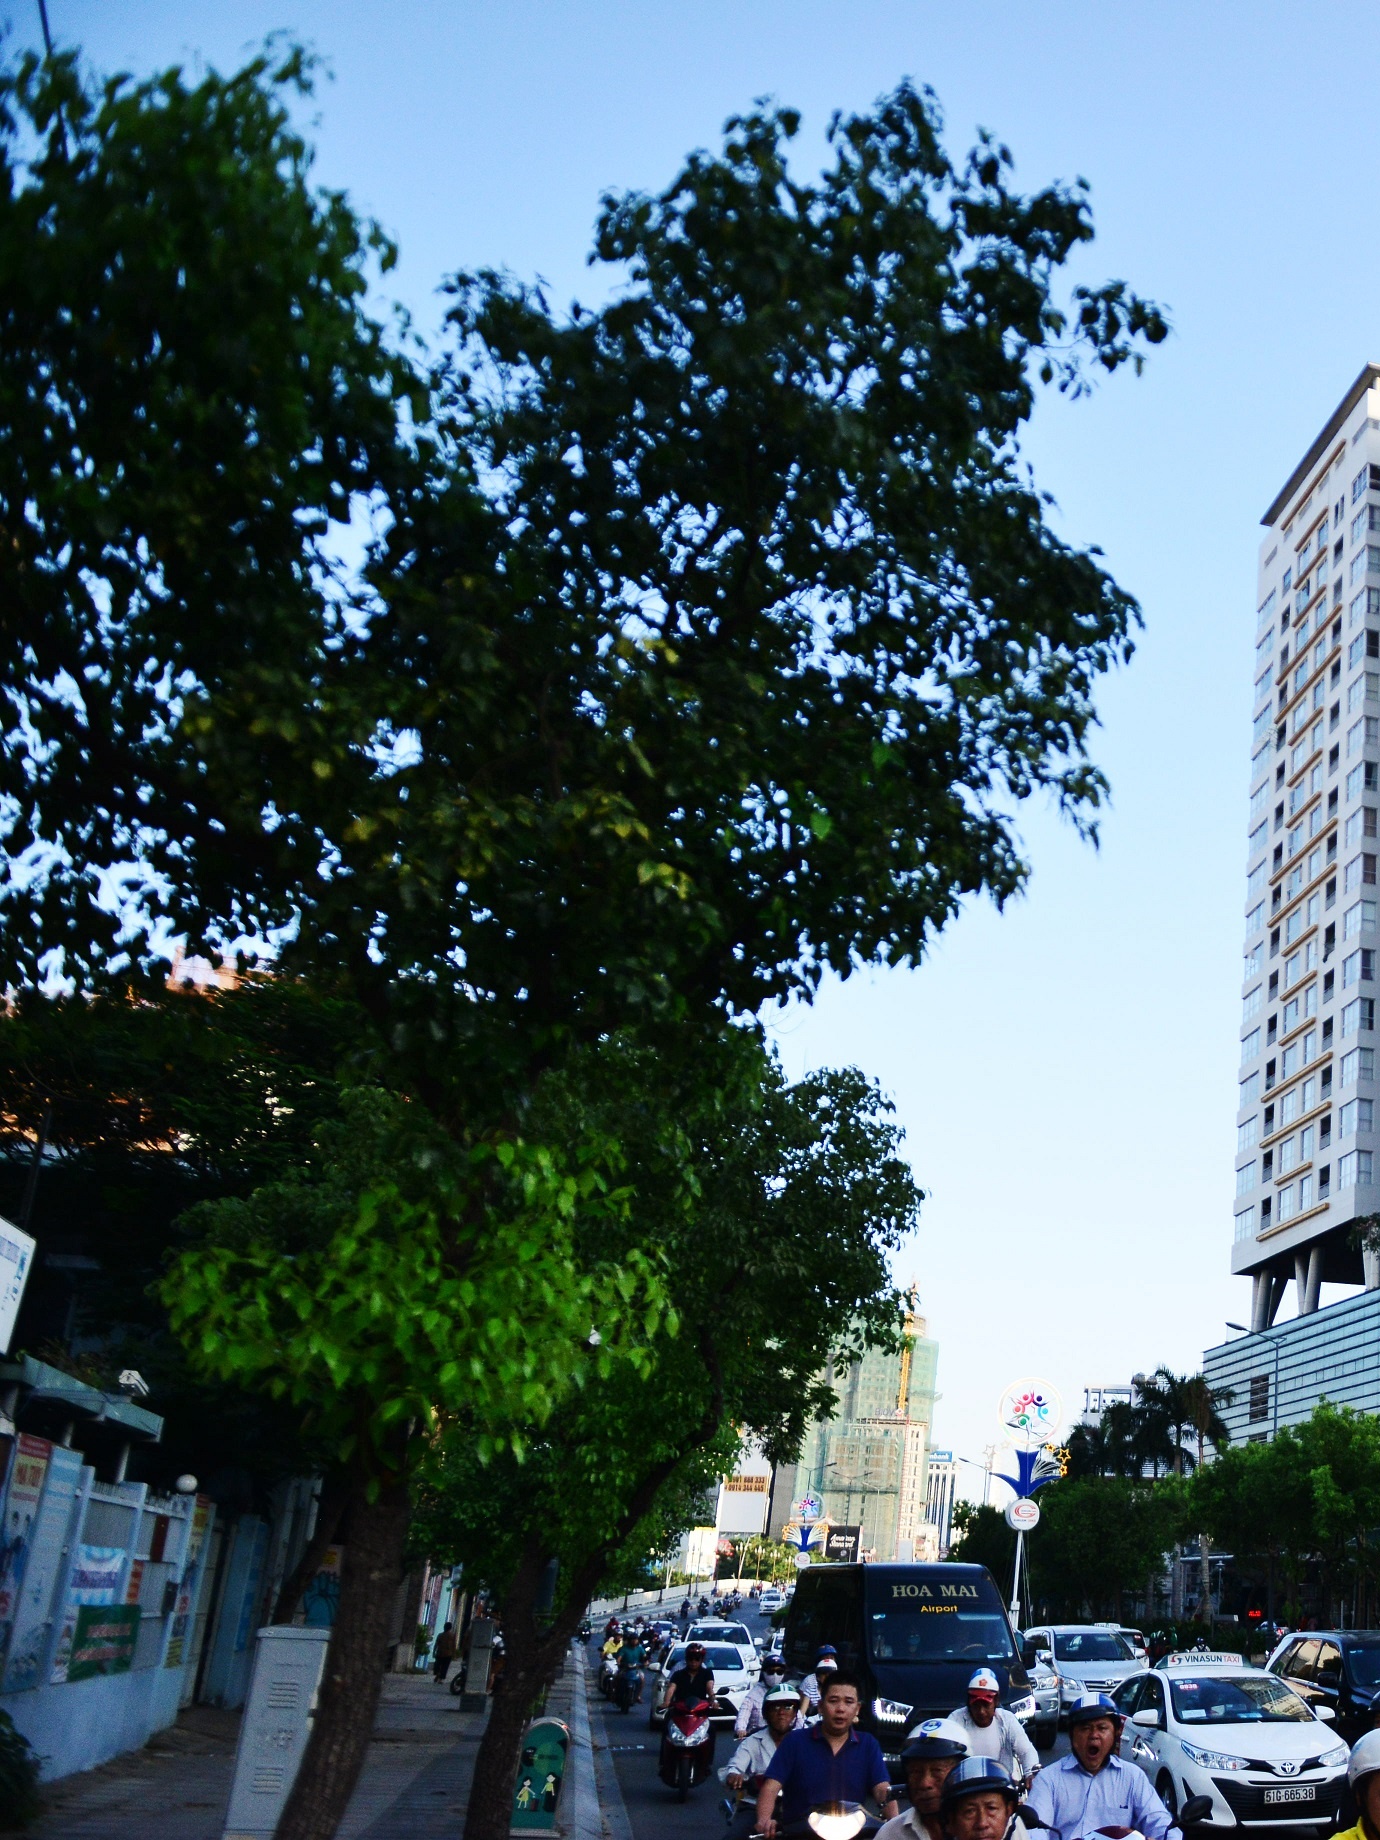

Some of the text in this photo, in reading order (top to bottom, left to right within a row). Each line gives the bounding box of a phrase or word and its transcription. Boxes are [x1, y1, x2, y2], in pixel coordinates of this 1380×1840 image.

[892, 1584, 979, 1598] HOA MAI
[920, 1605, 958, 1614] Airport
